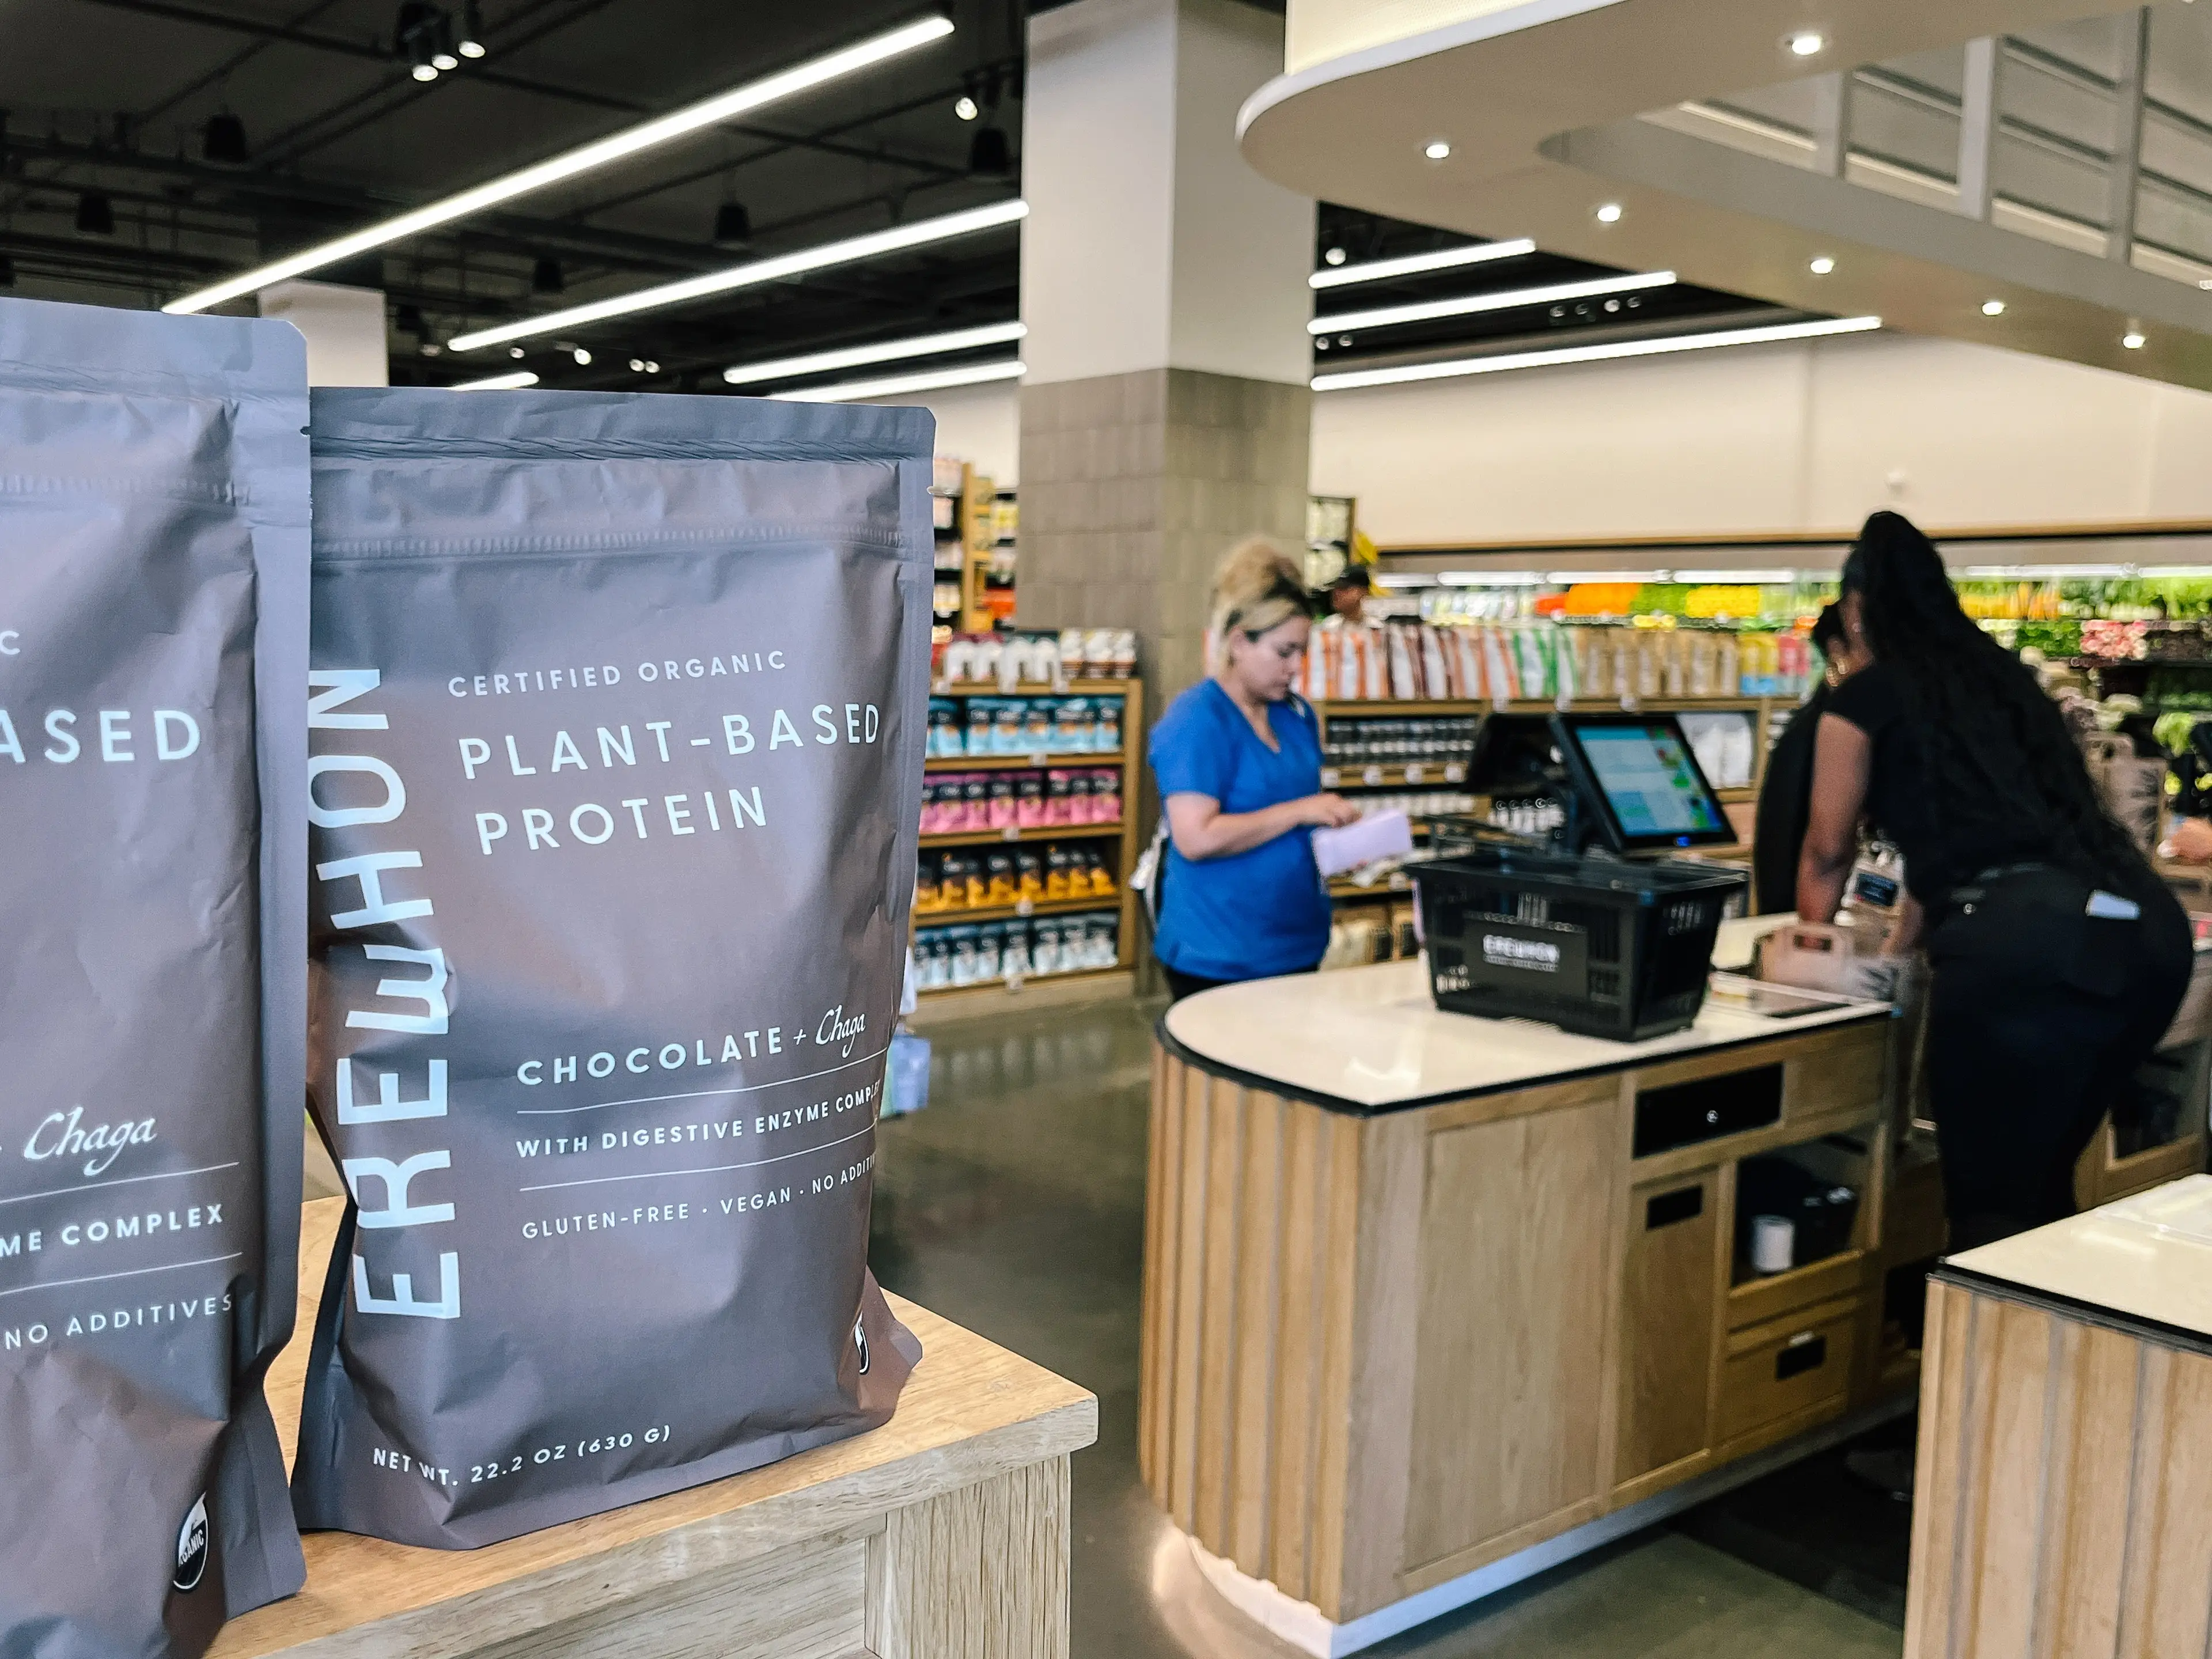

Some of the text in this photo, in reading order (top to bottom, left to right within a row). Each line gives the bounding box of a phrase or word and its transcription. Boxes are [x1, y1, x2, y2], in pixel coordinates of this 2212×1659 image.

[448, 650, 786, 698] CERTIFIED ORGANIC
[458, 703, 880, 780] PLANT-BASED
[475, 786, 766, 855] PROTEIN
[307, 668, 461, 1320] EREWHON
[516, 1004, 867, 1086] CHOCOLATE + Chaga
[23, 1105, 157, 1176] Chaga
[516, 1136, 588, 1158] WITH
[602, 1120, 743, 1149] DIGESTIVE
[755, 1101, 828, 1134] ENZYME
[61, 1203, 222, 1245] COMPLEX
[522, 1203, 688, 1238] GLUTEN-FREE
[721, 1187, 790, 1214] VEGAN
[812, 1175, 834, 1194] NO
[5, 1294, 231, 1350] NO ADDITIVES
[373, 1425, 669, 1486] NET WT. 22.2 OZ (630 G)
